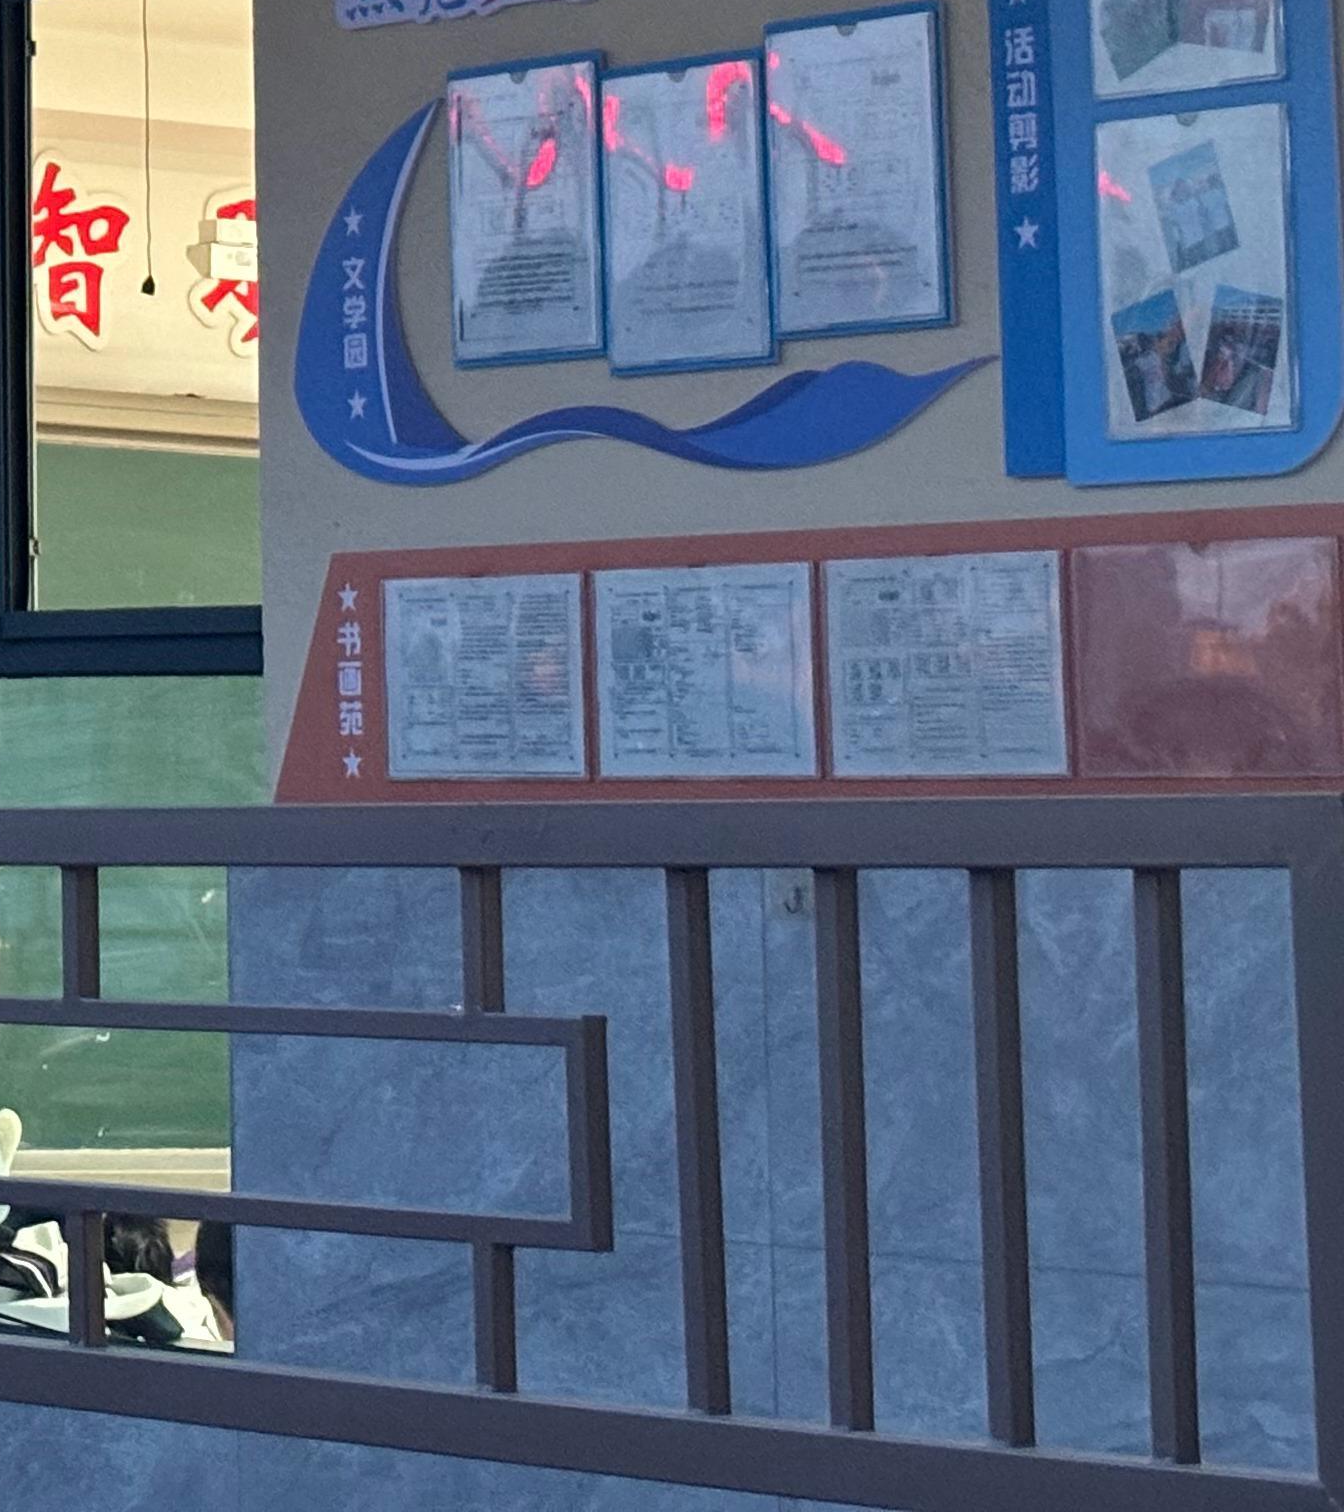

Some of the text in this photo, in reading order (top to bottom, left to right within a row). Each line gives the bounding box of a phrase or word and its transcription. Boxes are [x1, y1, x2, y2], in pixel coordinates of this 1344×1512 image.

[1004, 26, 1040, 196] 活动剪影
[341, 256, 369, 369] 文学园
[337, 621, 364, 736] 书画苑
